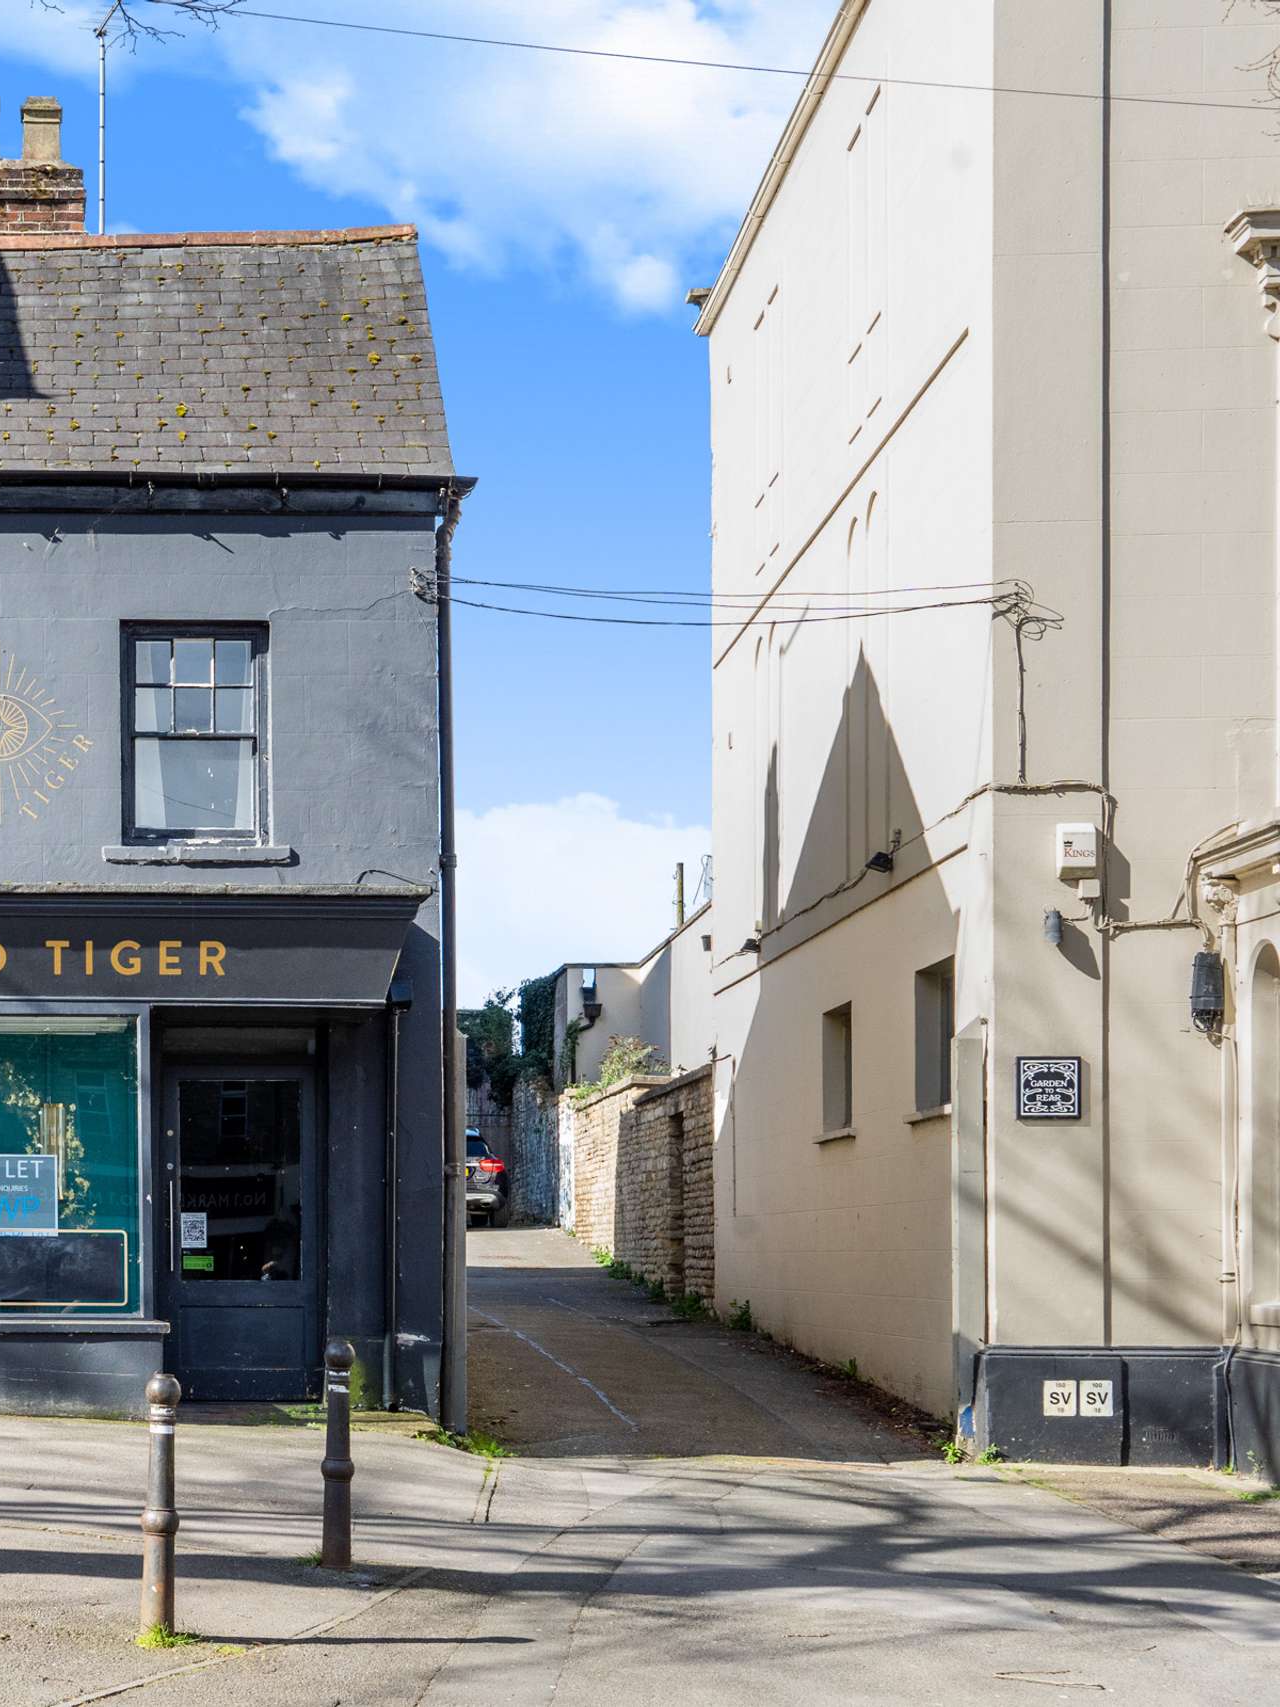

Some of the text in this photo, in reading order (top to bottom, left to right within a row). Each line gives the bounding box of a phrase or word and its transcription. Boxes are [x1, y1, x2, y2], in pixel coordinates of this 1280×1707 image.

[19, 734, 94, 820] TIGER
[45, 939, 227, 976] TIGER
[1030, 1079, 1068, 1087] GARDEN
[1036, 1094, 1062, 1102] REAR
[5, 1159, 44, 1179] LET
[1050, 1391, 1072, 1405] SV
[1086, 1391, 1109, 1405] SV
